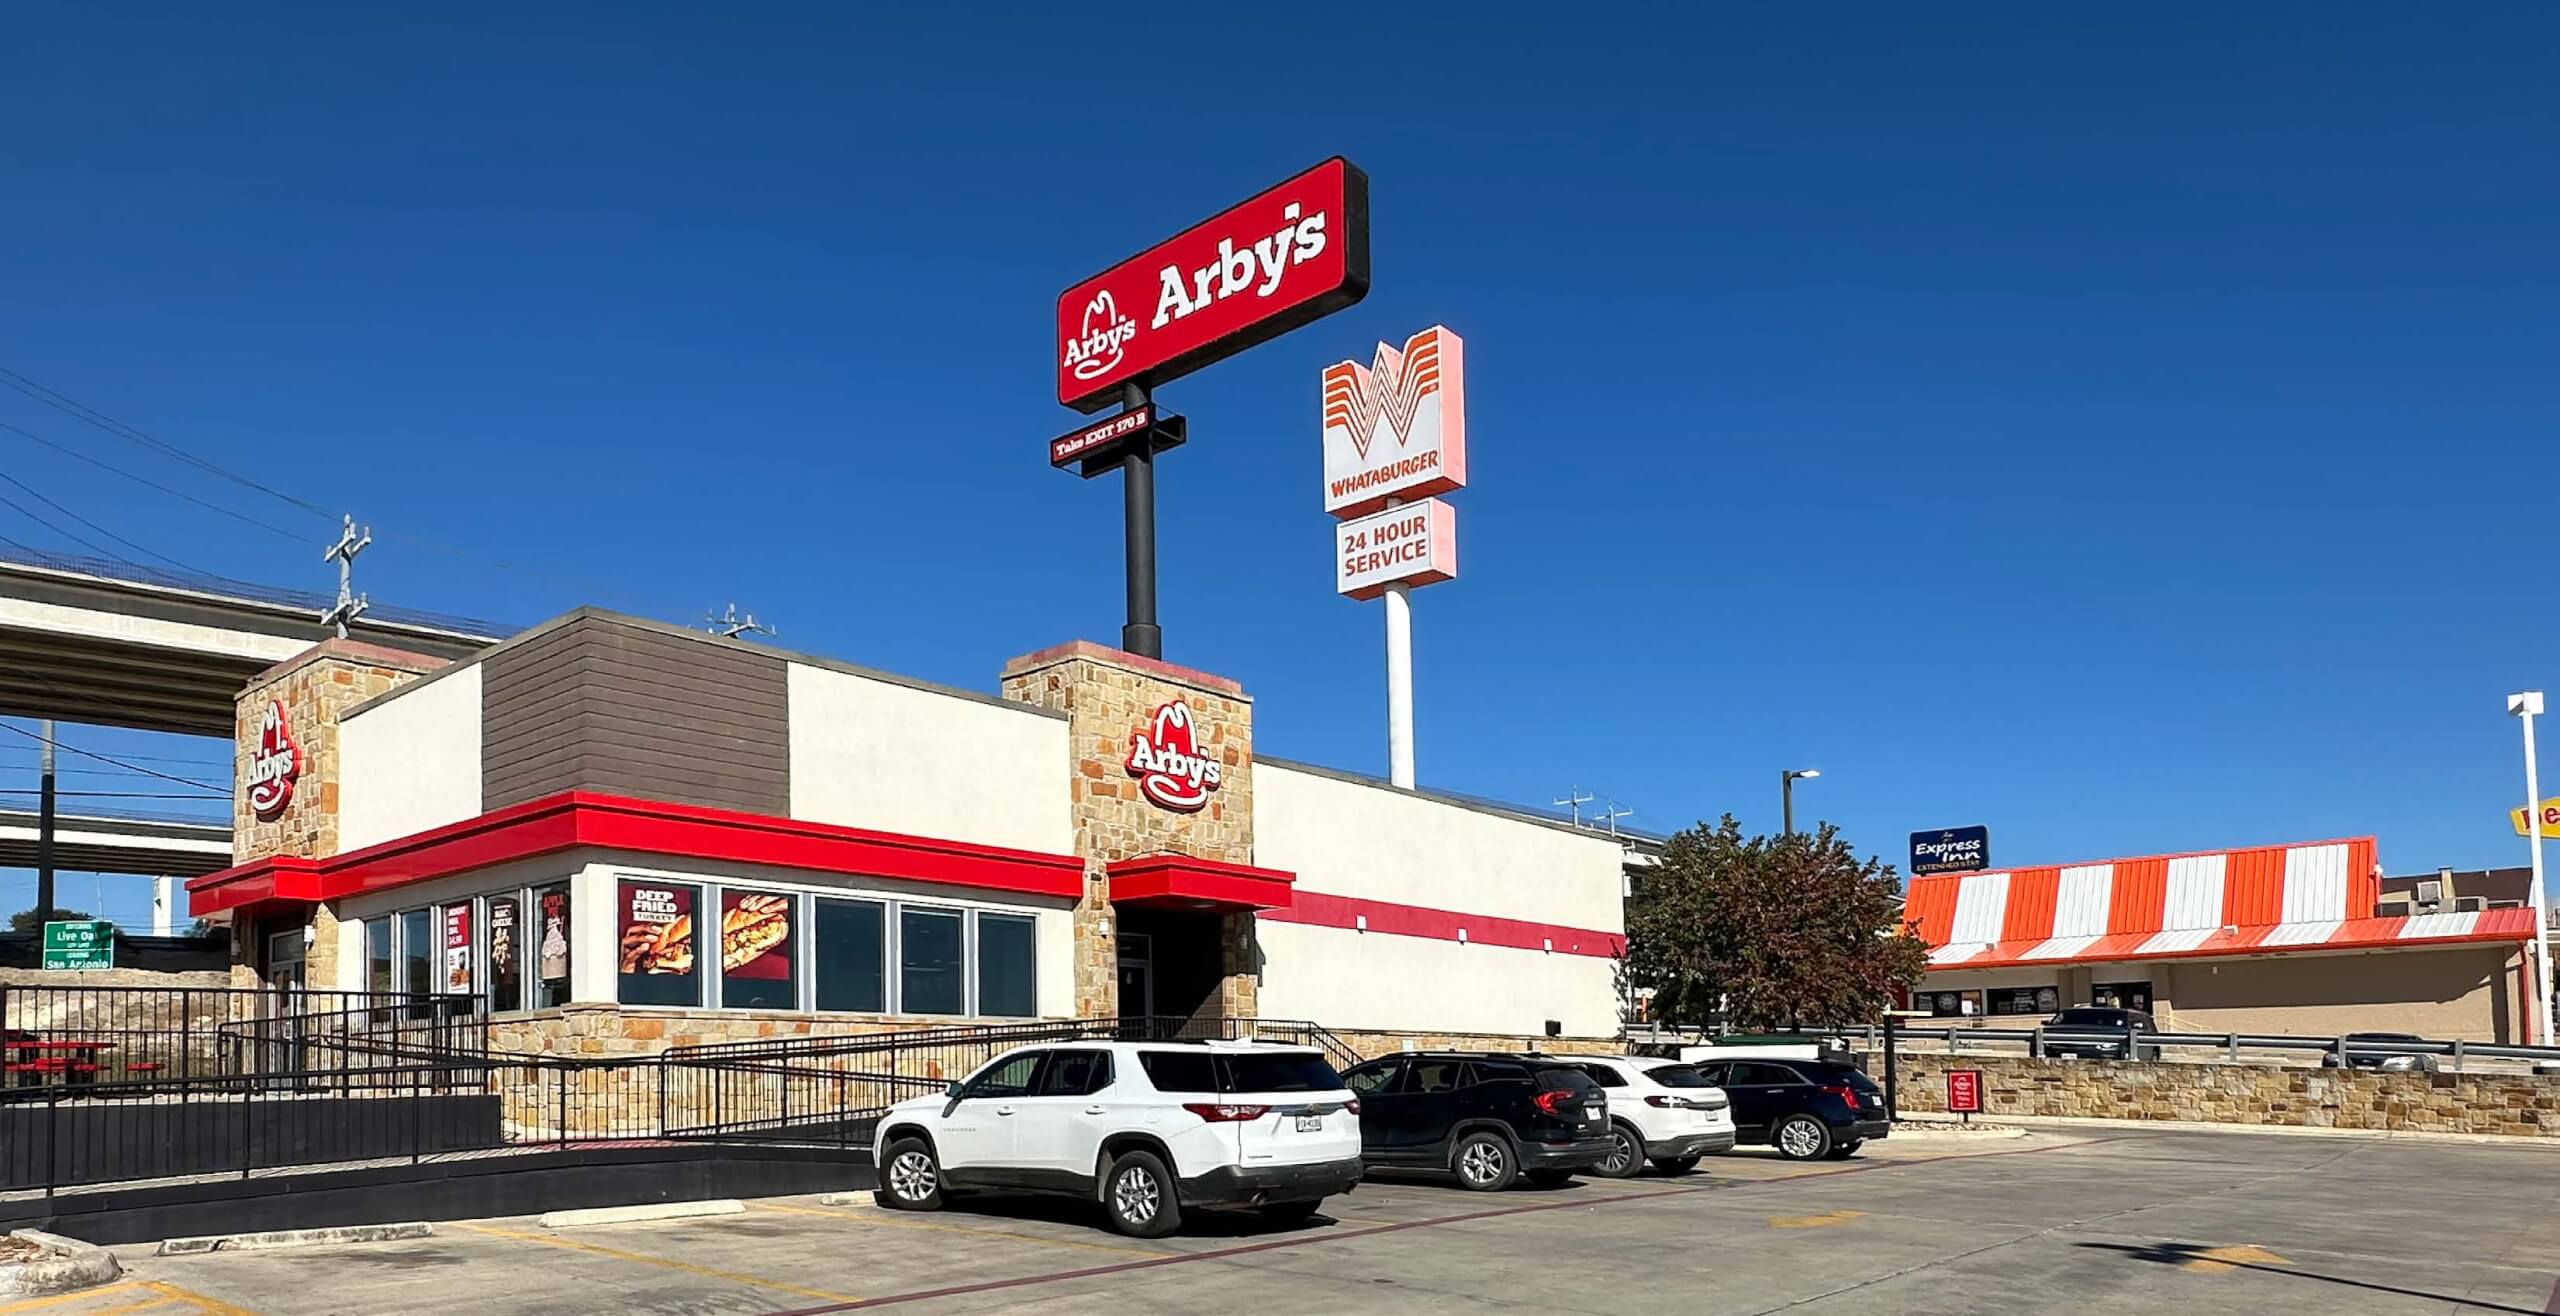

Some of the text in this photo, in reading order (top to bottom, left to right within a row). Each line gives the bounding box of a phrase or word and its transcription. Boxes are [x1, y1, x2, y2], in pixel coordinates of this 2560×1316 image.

[1151, 201, 1327, 330] Arby's
[1063, 315, 1136, 367] Arby's
[1056, 412, 1146, 456] Take EXIT 170 B
[1330, 450, 1439, 498] WHATABURGER
[1345, 516, 1426, 555] 24 HOUR
[1344, 539, 1427, 577] SERVICE
[246, 739, 293, 787] Arby's
[1131, 734, 1221, 788] Arby's
[1915, 839, 1981, 857] Express
[1942, 851, 1981, 862] Inn
[632, 900, 678, 913] FRIED
[635, 889, 674, 902] DEEP
[56, 931, 77, 941] Live
[46, 960, 65, 969] San
